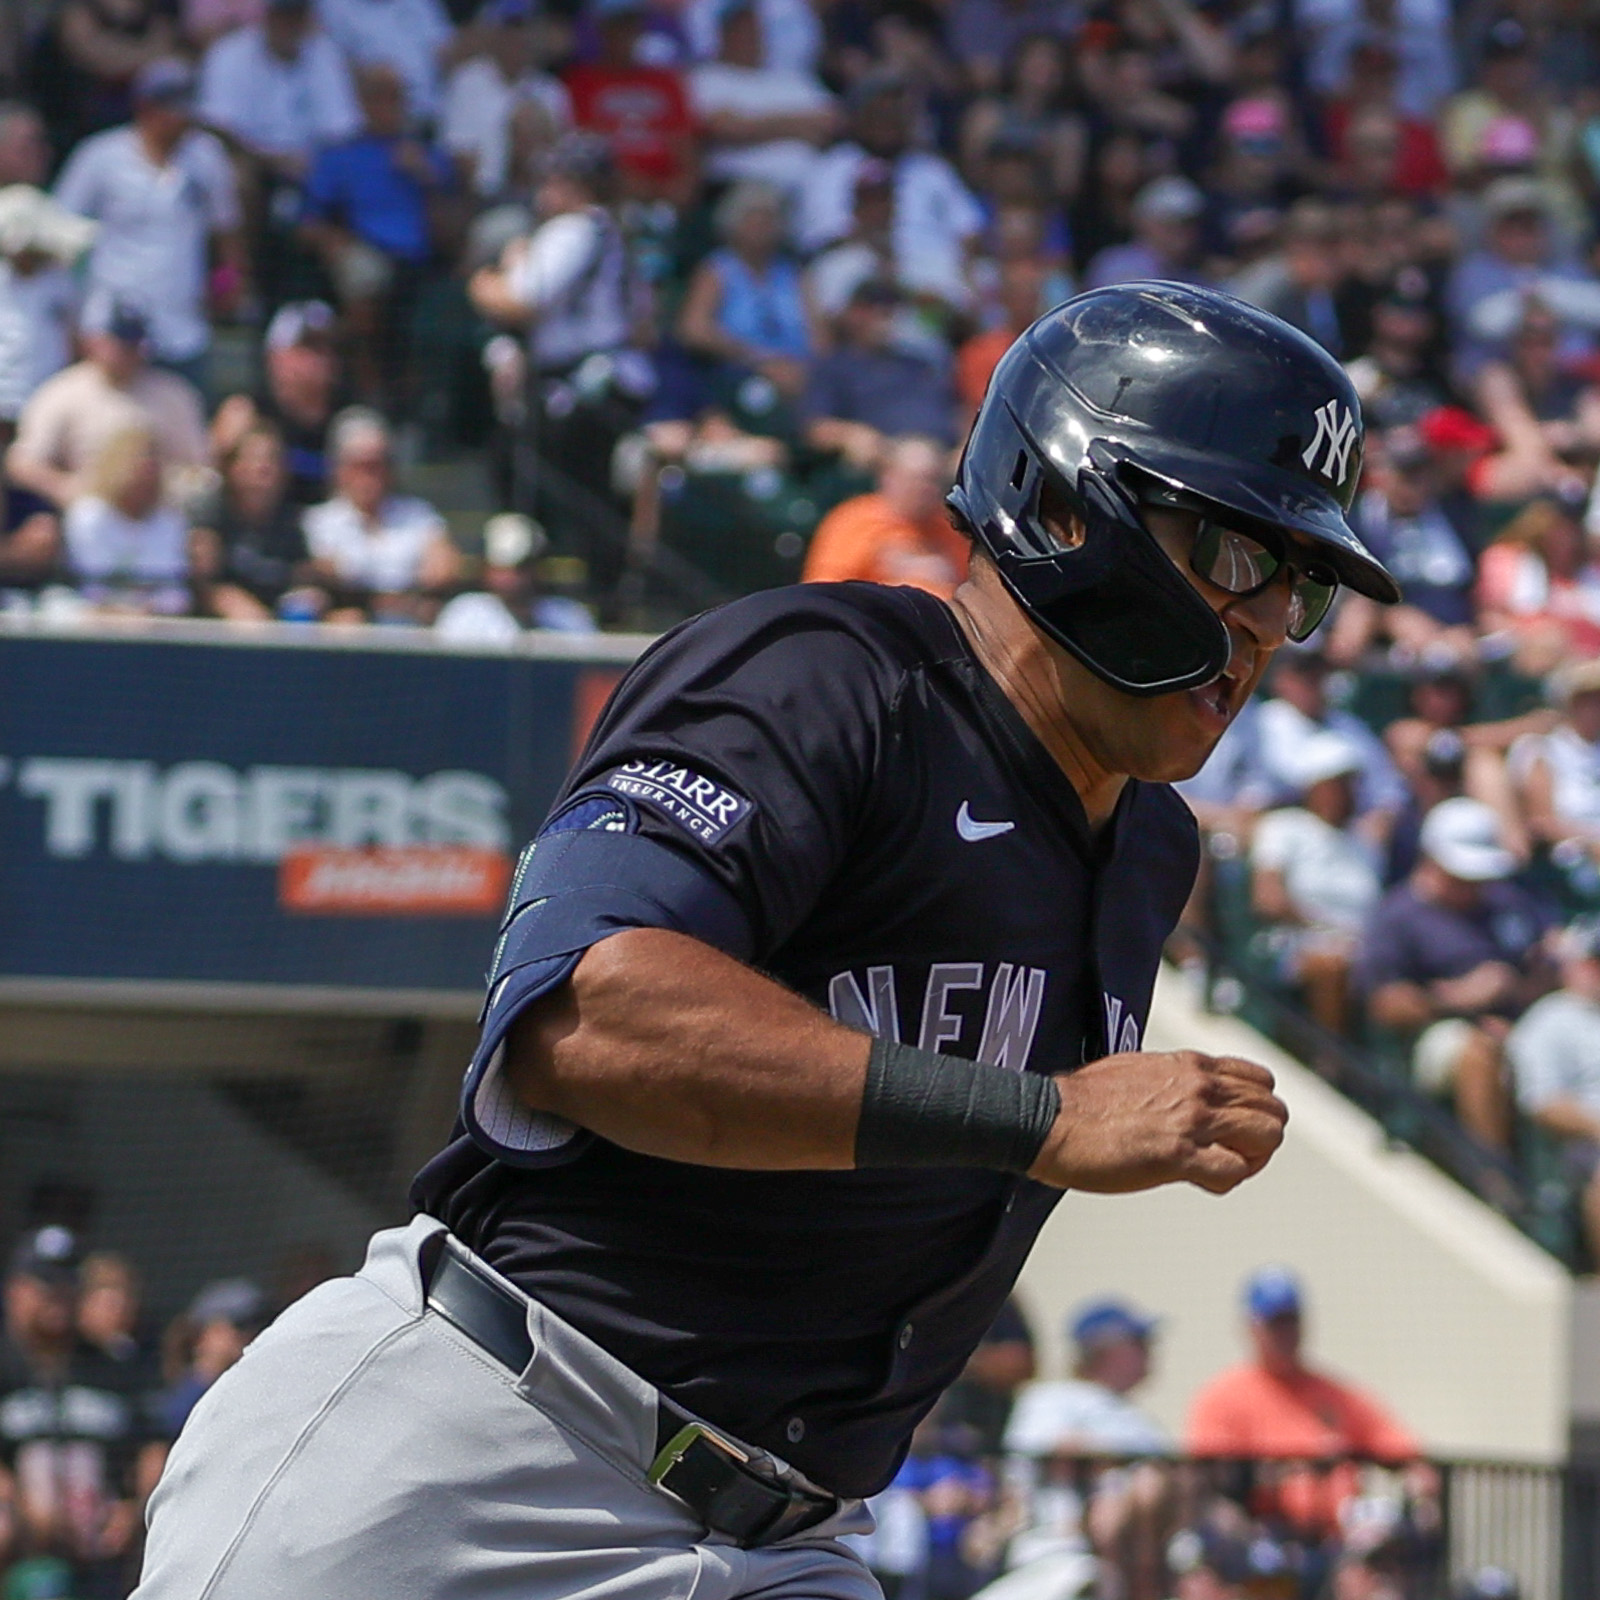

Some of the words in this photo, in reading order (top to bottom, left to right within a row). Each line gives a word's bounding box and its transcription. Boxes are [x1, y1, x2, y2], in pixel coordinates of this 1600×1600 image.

[1302, 399, 1356, 487] NY
[17, 755, 510, 863] TIGERS
[611, 778, 714, 840] INSURANCE
[621, 757, 738, 825] STARR
